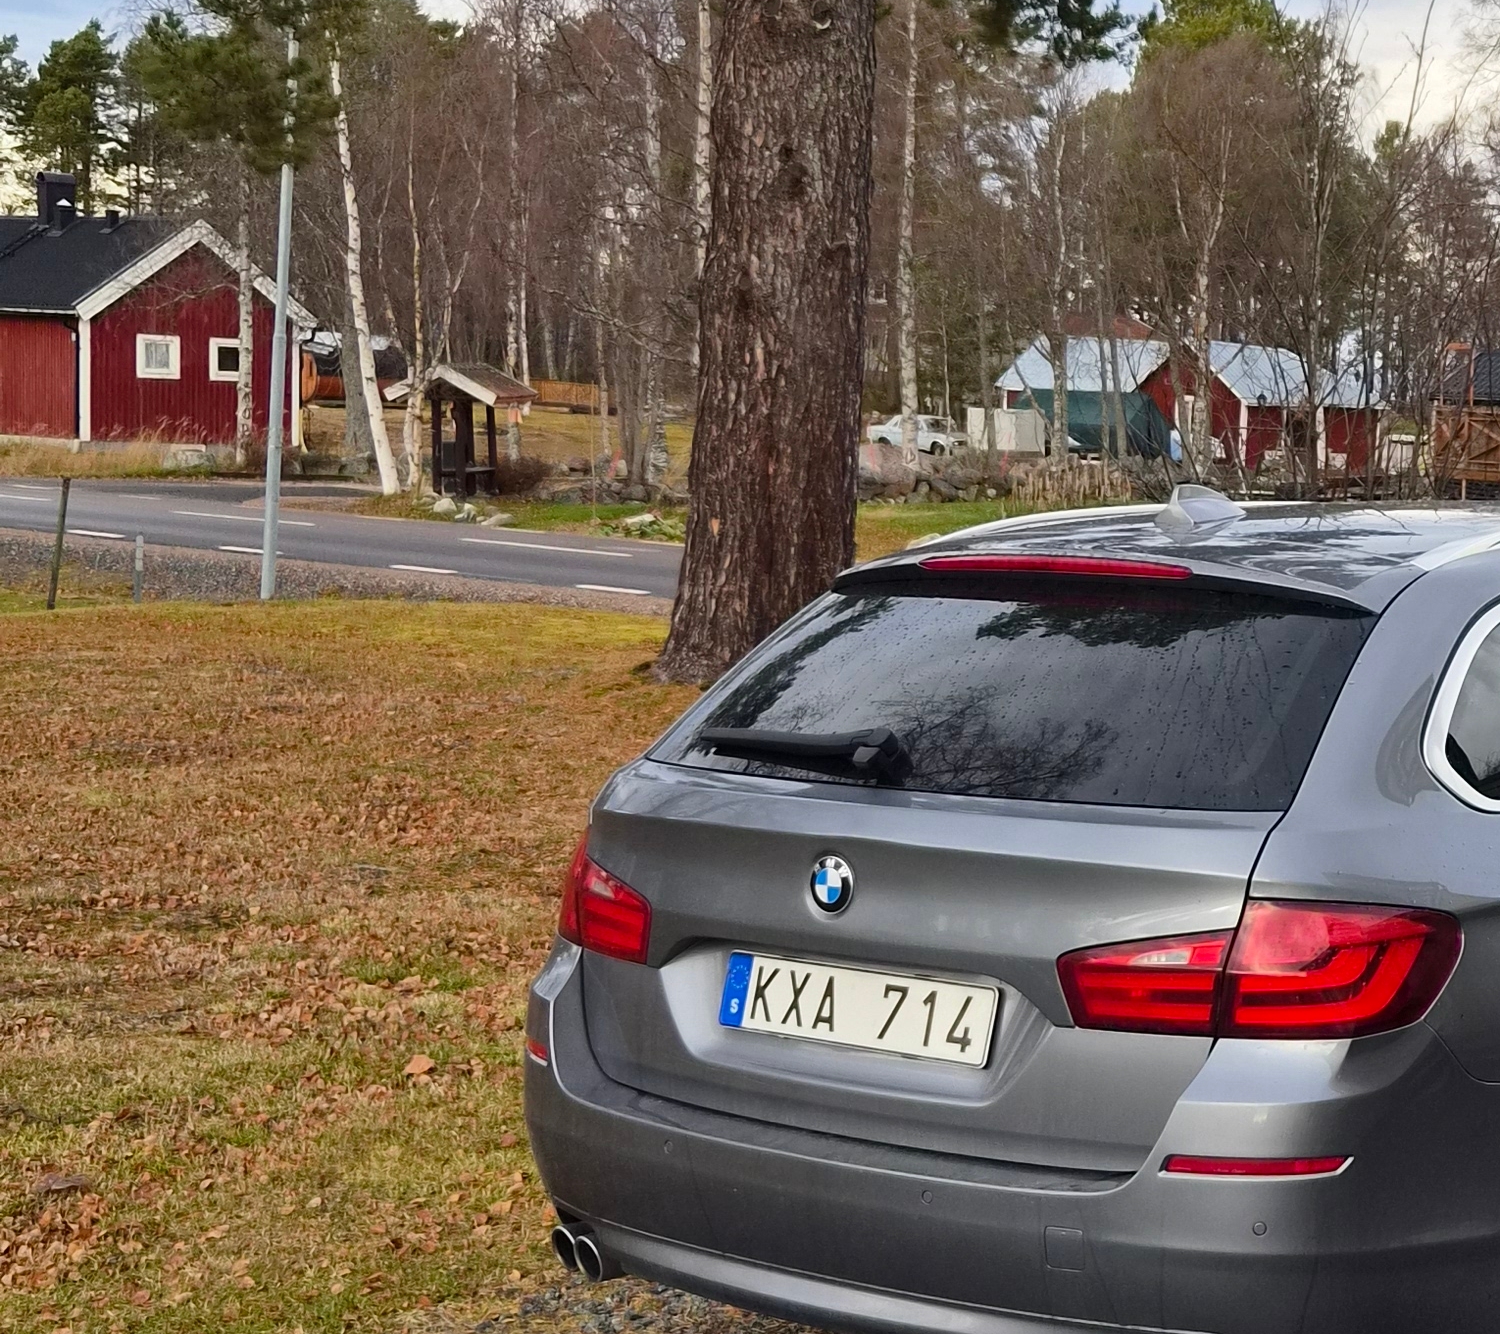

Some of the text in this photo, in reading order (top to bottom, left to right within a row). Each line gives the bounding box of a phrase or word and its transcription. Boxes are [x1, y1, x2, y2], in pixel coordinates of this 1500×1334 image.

[729, 998, 740, 1014] S
[750, 965, 972, 1053] KXA 714
